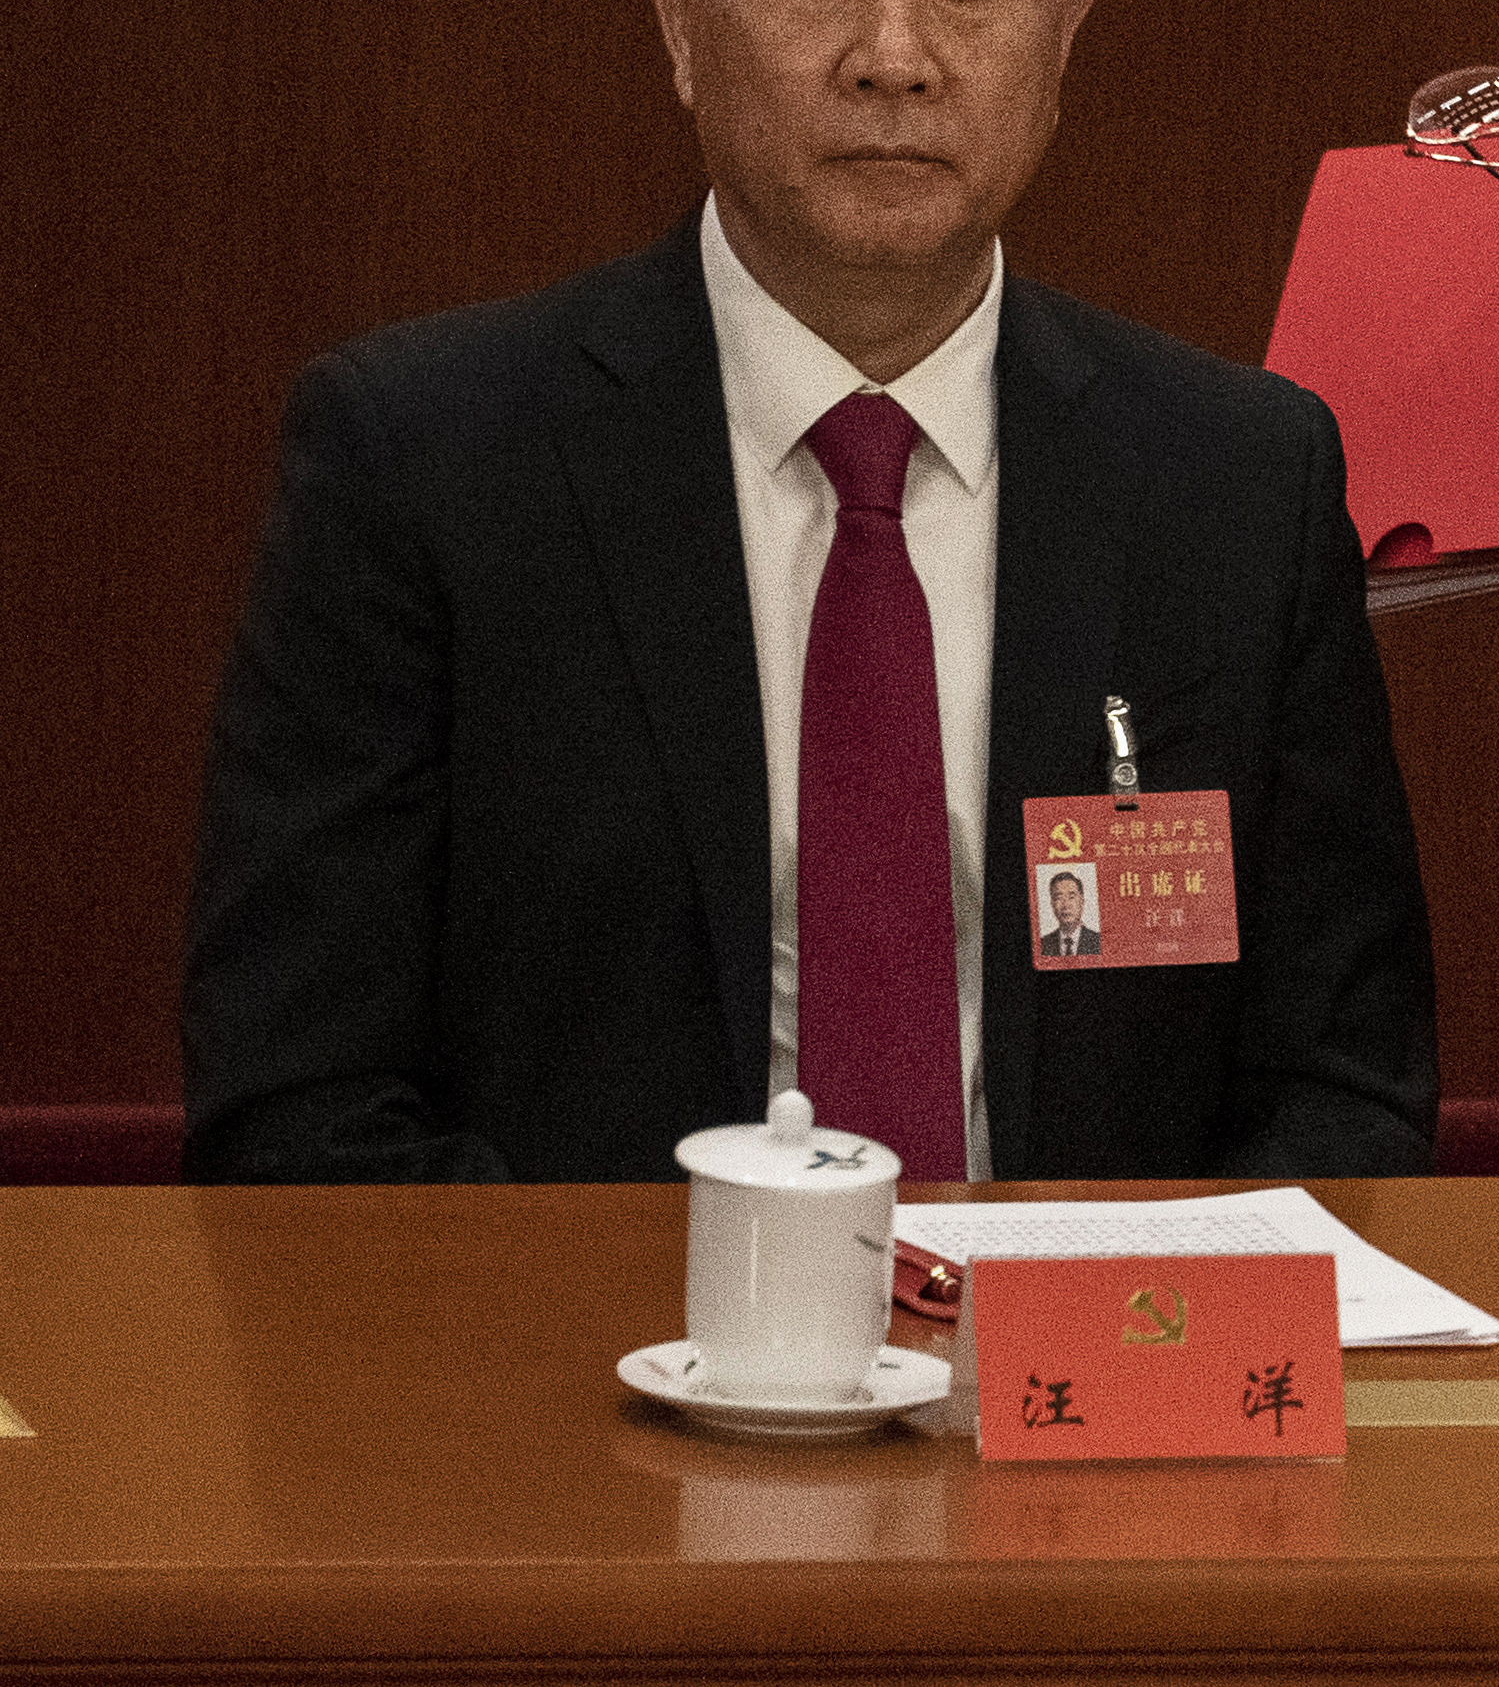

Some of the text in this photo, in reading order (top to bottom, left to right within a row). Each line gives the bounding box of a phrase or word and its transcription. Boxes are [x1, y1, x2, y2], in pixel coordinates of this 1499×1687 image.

[1108, 818, 1209, 841] 中国共产党
[1118, 869, 1208, 898] 出席证
[1021, 1361, 1304, 1437] 汪洋
